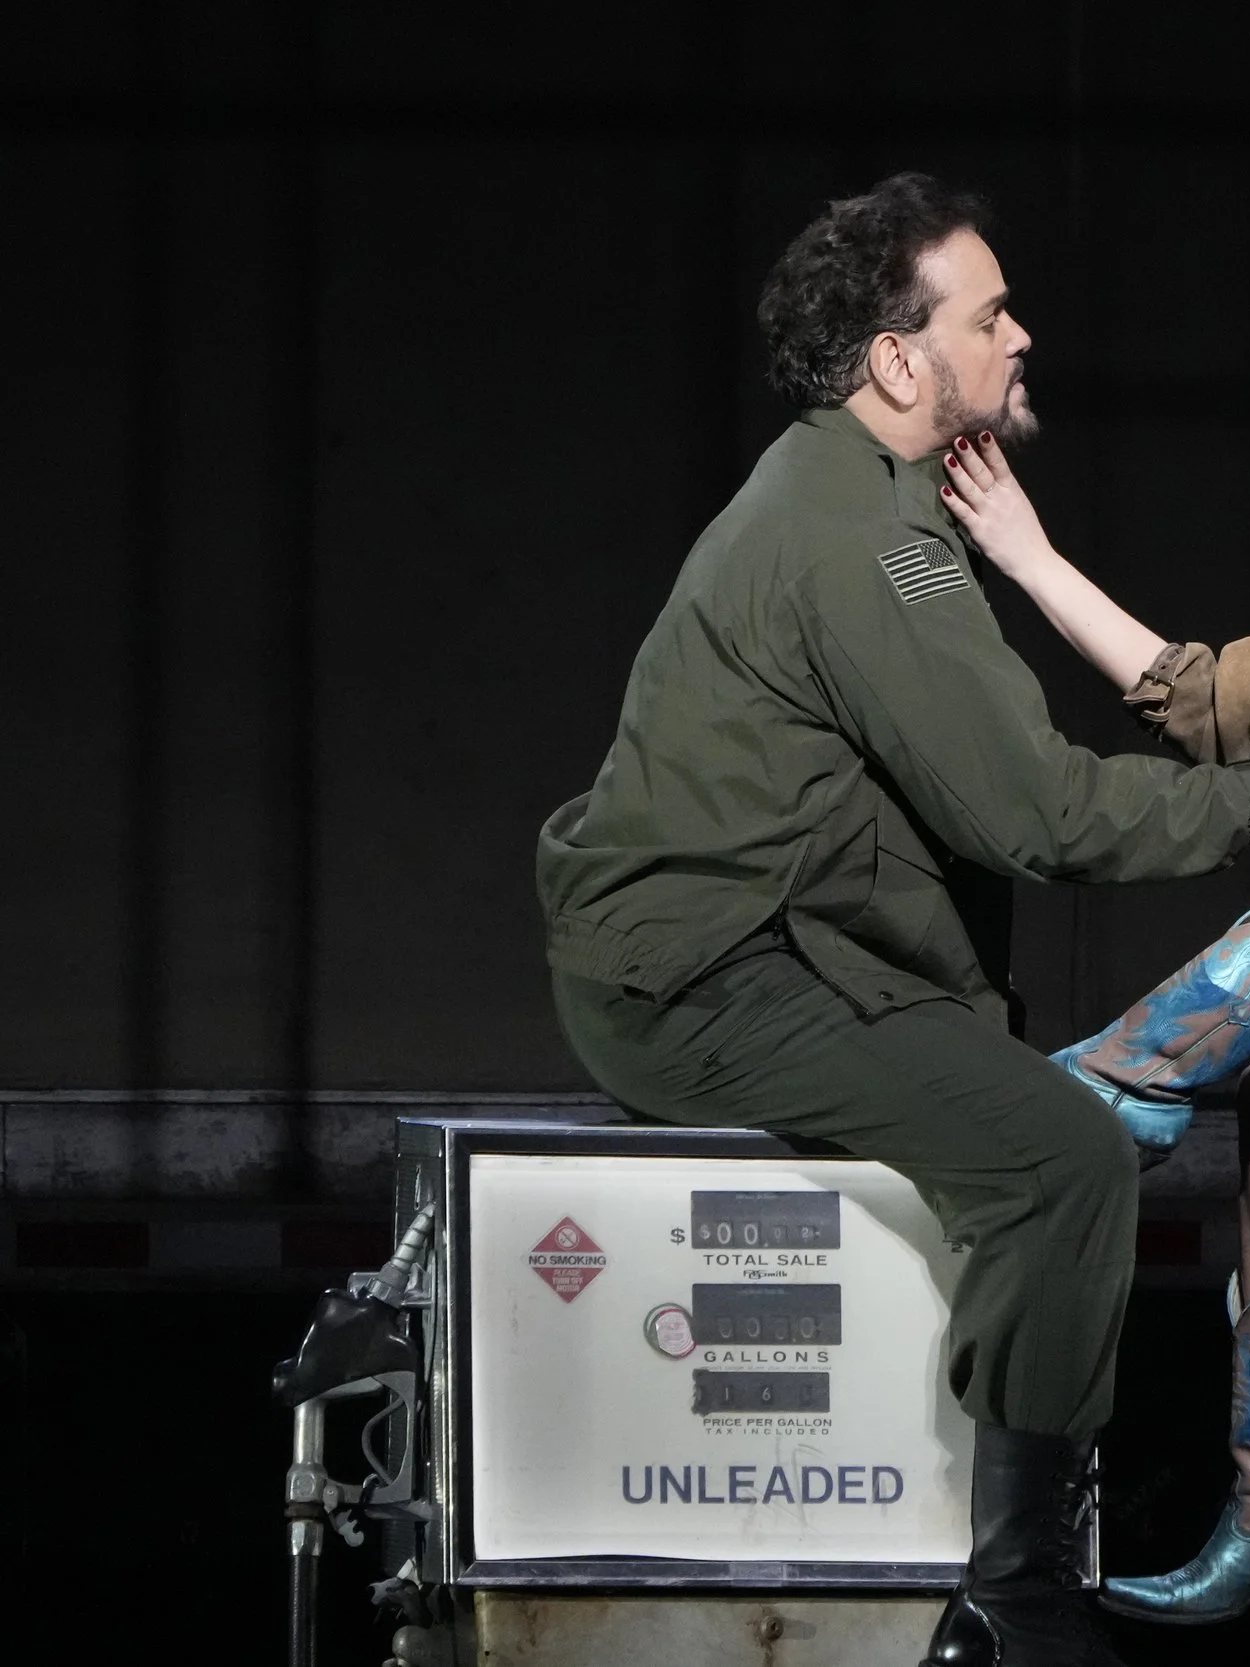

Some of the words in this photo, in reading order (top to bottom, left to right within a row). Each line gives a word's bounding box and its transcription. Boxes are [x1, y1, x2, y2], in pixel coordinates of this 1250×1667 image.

[670, 1227, 685, 1245] $
[528, 1255, 547, 1265] NO
[549, 1255, 607, 1265] SMOKING
[703, 1254, 768, 1265] TOTAL
[777, 1254, 828, 1265] SALE
[704, 1351, 829, 1363] GALLONS
[703, 1418, 742, 1427] PRICE
[747, 1418, 772, 1427] PER
[777, 1418, 832, 1427] GALLON
[622, 1465, 904, 1504] UNLEADED
